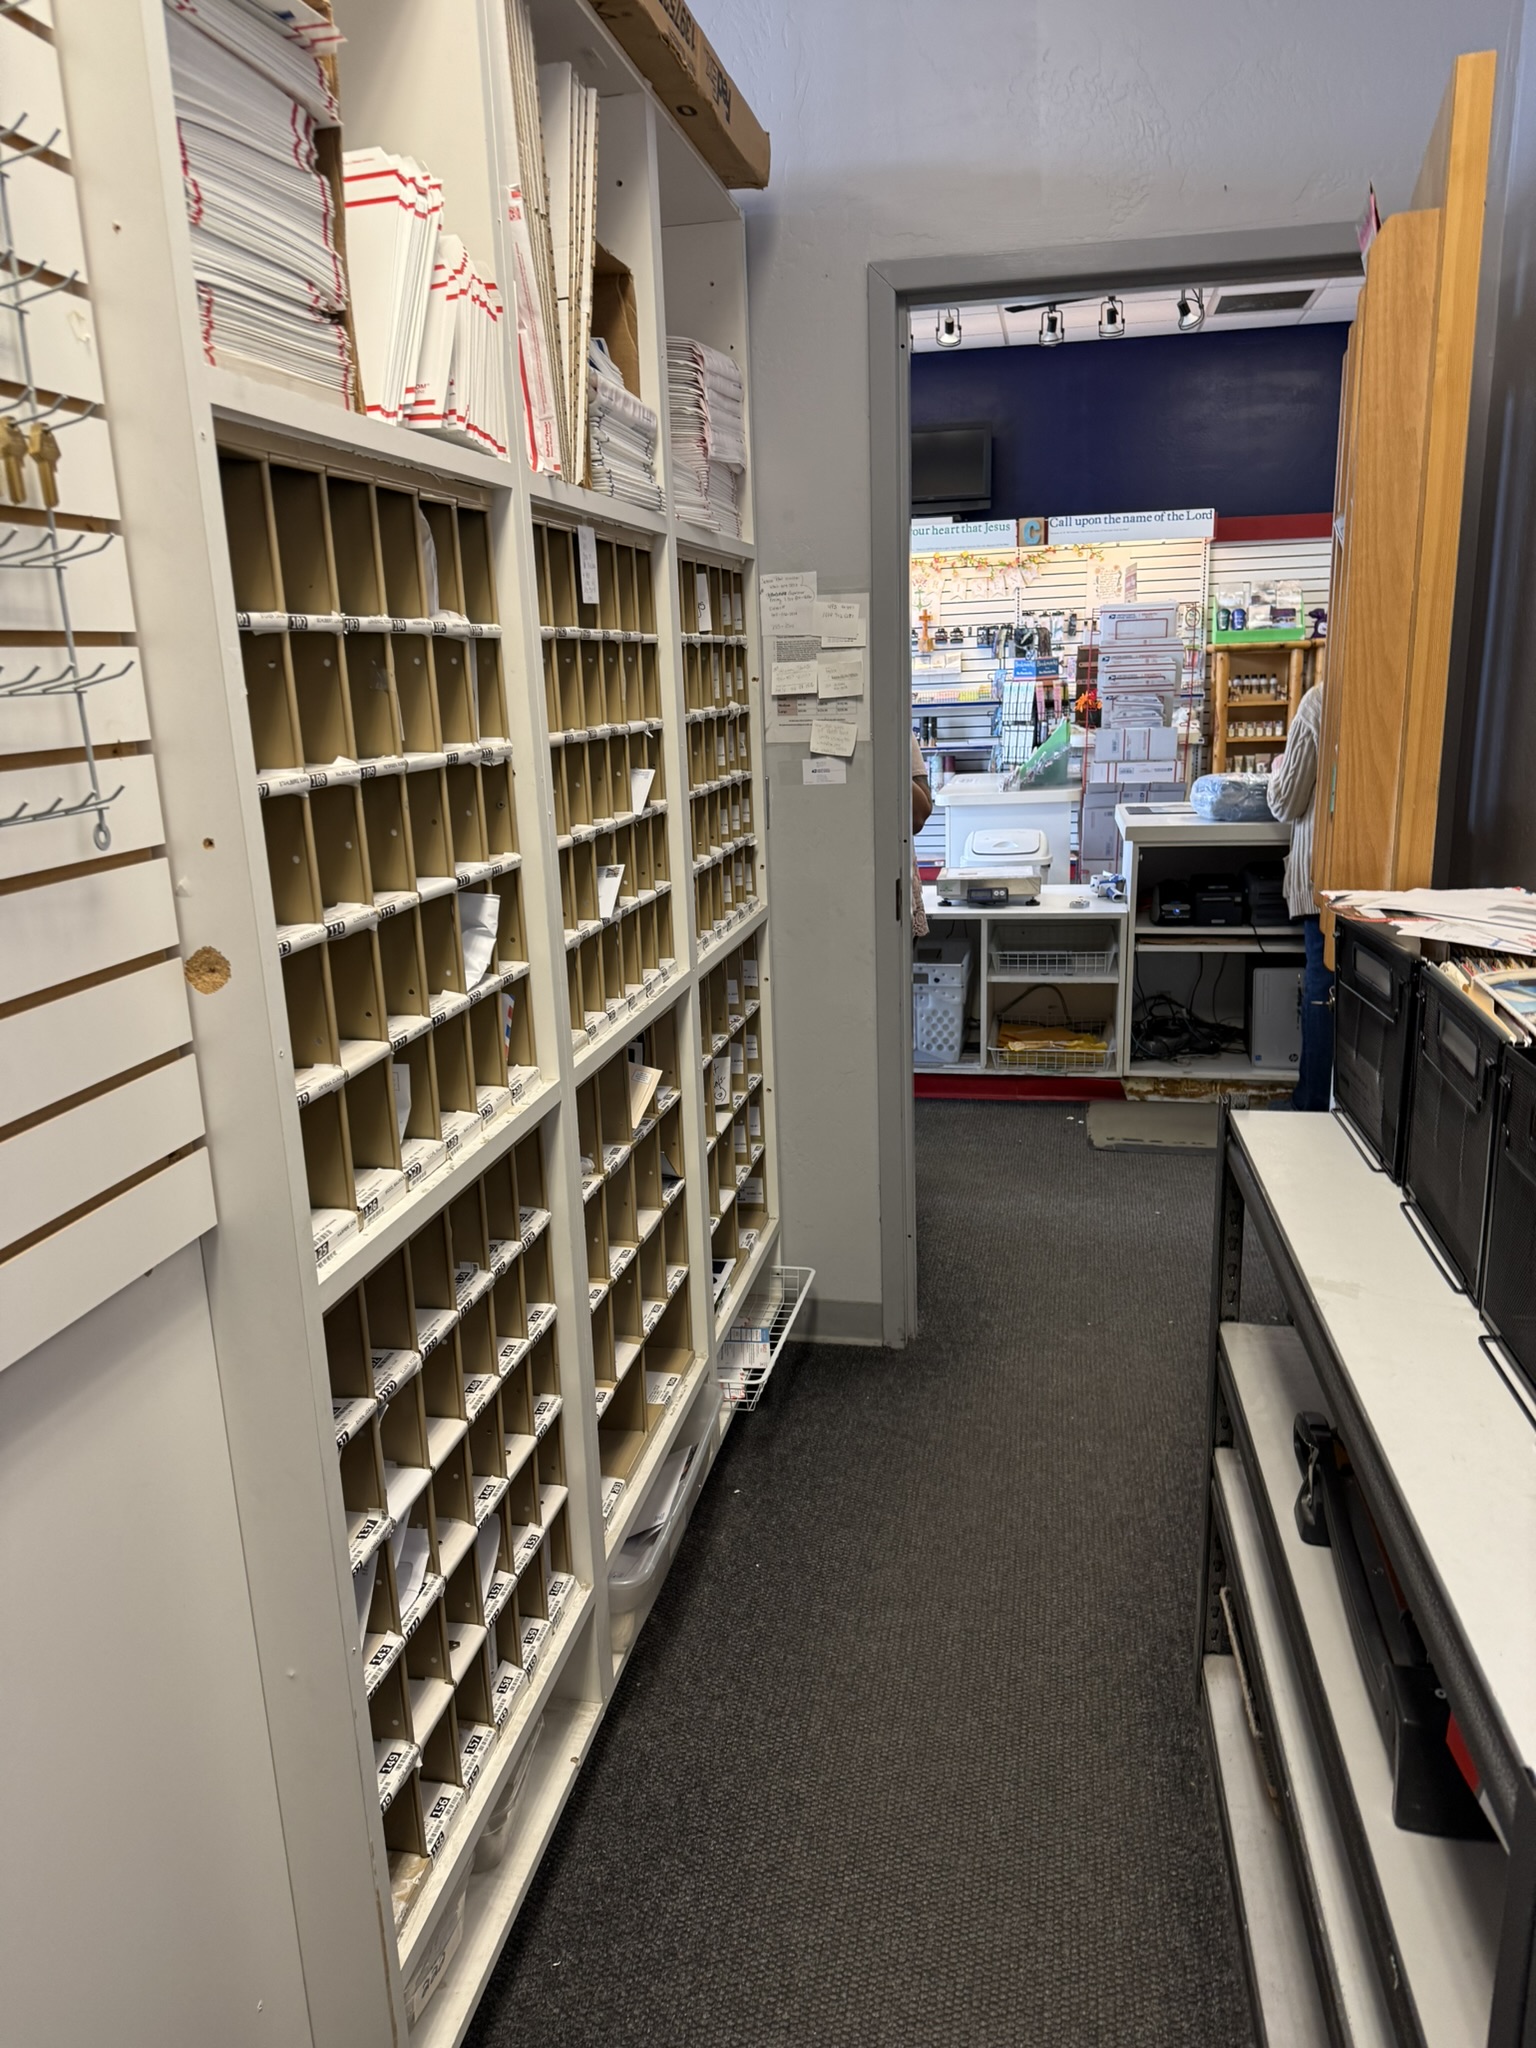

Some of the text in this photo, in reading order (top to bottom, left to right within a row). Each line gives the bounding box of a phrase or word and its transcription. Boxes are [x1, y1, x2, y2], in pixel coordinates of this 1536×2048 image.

[1049, 509, 1213, 528] Call upon the name of the Lord
[911, 522, 1011, 536] our heart that Jesus
[1023, 519, 1041, 545] C
[237, 614, 250, 627] 01
[291, 617, 307, 630] 102
[345, 619, 360, 631] 103
[393, 620, 406, 632] 104
[311, 774, 327, 787] 108
[361, 767, 376, 781] 109
[258, 784, 269, 798] 07
[381, 904, 396, 919] 115
[327, 922, 345, 937] 114
[407, 1162, 422, 1180] 127
[363, 1198, 379, 1219] 126
[528, 1310, 543, 1322] 142
[501, 1344, 516, 1358] 141
[465, 1380, 482, 1394] 140
[479, 1485, 496, 1501] 146
[356, 1518, 378, 1539] 137
[524, 1534, 540, 1549] 153
[487, 1583, 504, 1599] 152
[549, 1582, 563, 1597] 160
[524, 1628, 539, 1644] 159
[369, 1645, 393, 1666] 143
[498, 1676, 514, 1693] 158
[465, 1735, 483, 1754] 157
[380, 1752, 402, 1774] 149
[431, 1797, 451, 1819] 156
